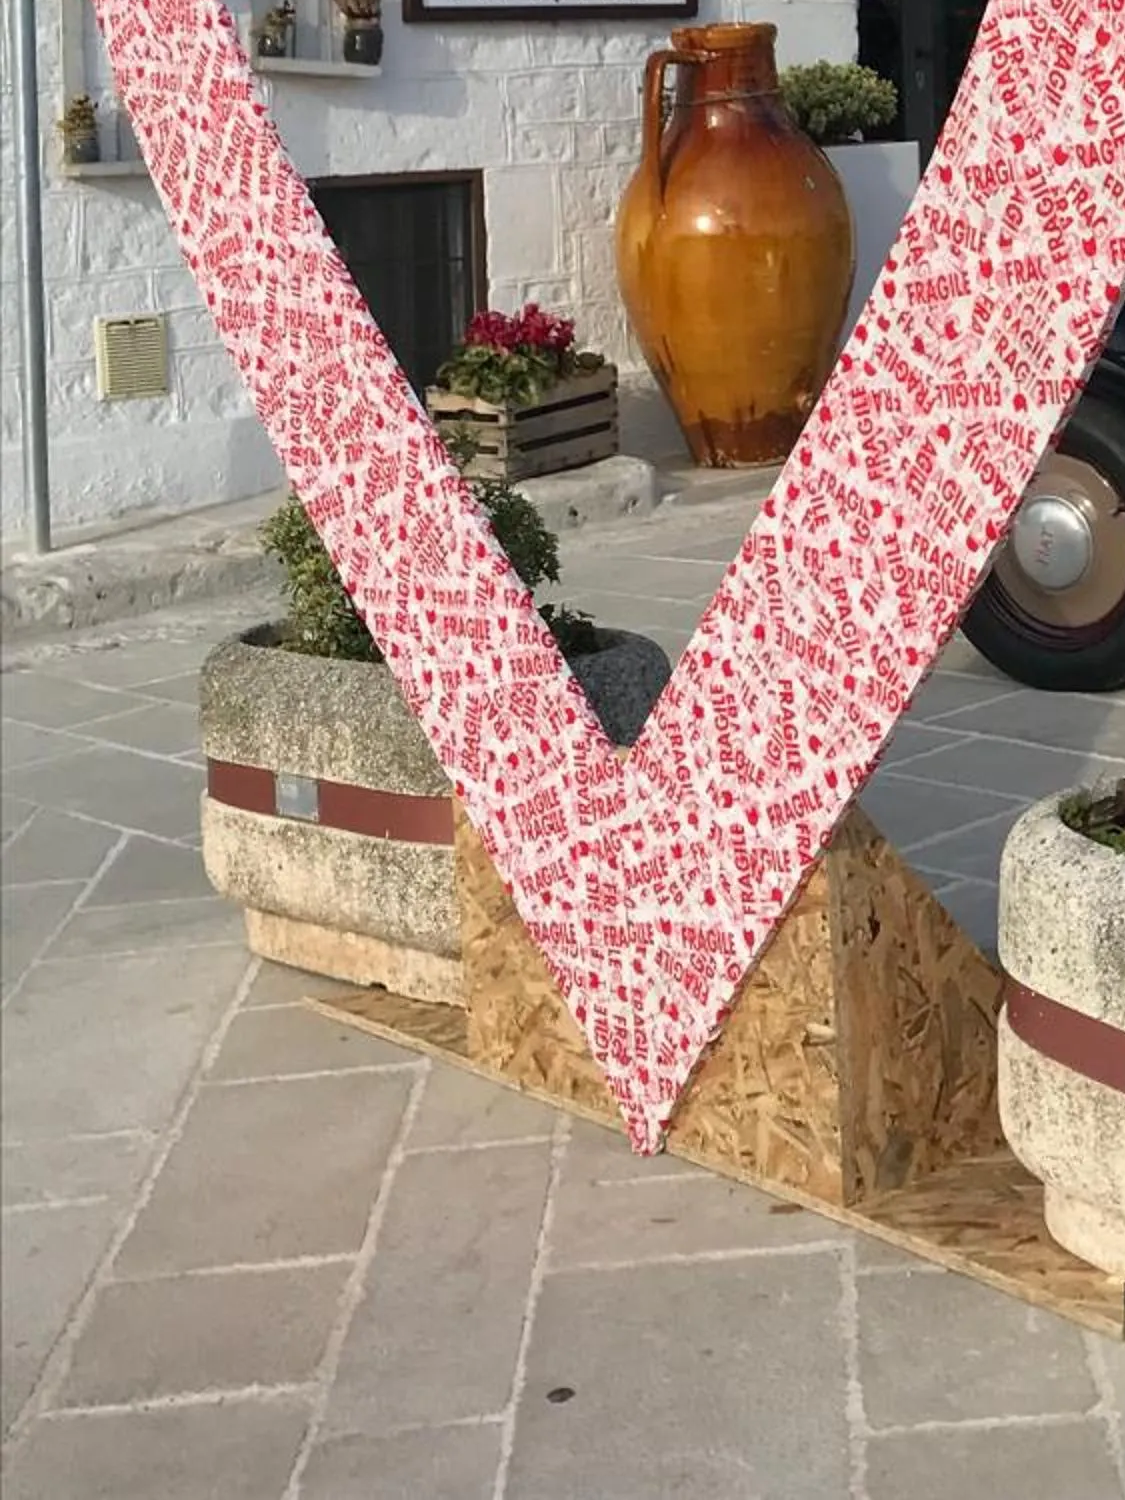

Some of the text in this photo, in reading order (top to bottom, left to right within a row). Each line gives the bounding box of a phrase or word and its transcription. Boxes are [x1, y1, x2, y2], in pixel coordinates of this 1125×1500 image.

[924, 205, 987, 252] FRAGILE
[906, 271, 972, 304] FRAGILE
[884, 532, 917, 629] FRAGILE
[910, 532, 976, 587] FRAGILE
[711, 684, 735, 775] FRAGILE
[778, 679, 801, 774] FRAGILE
[731, 824, 754, 916] FRAGILE
